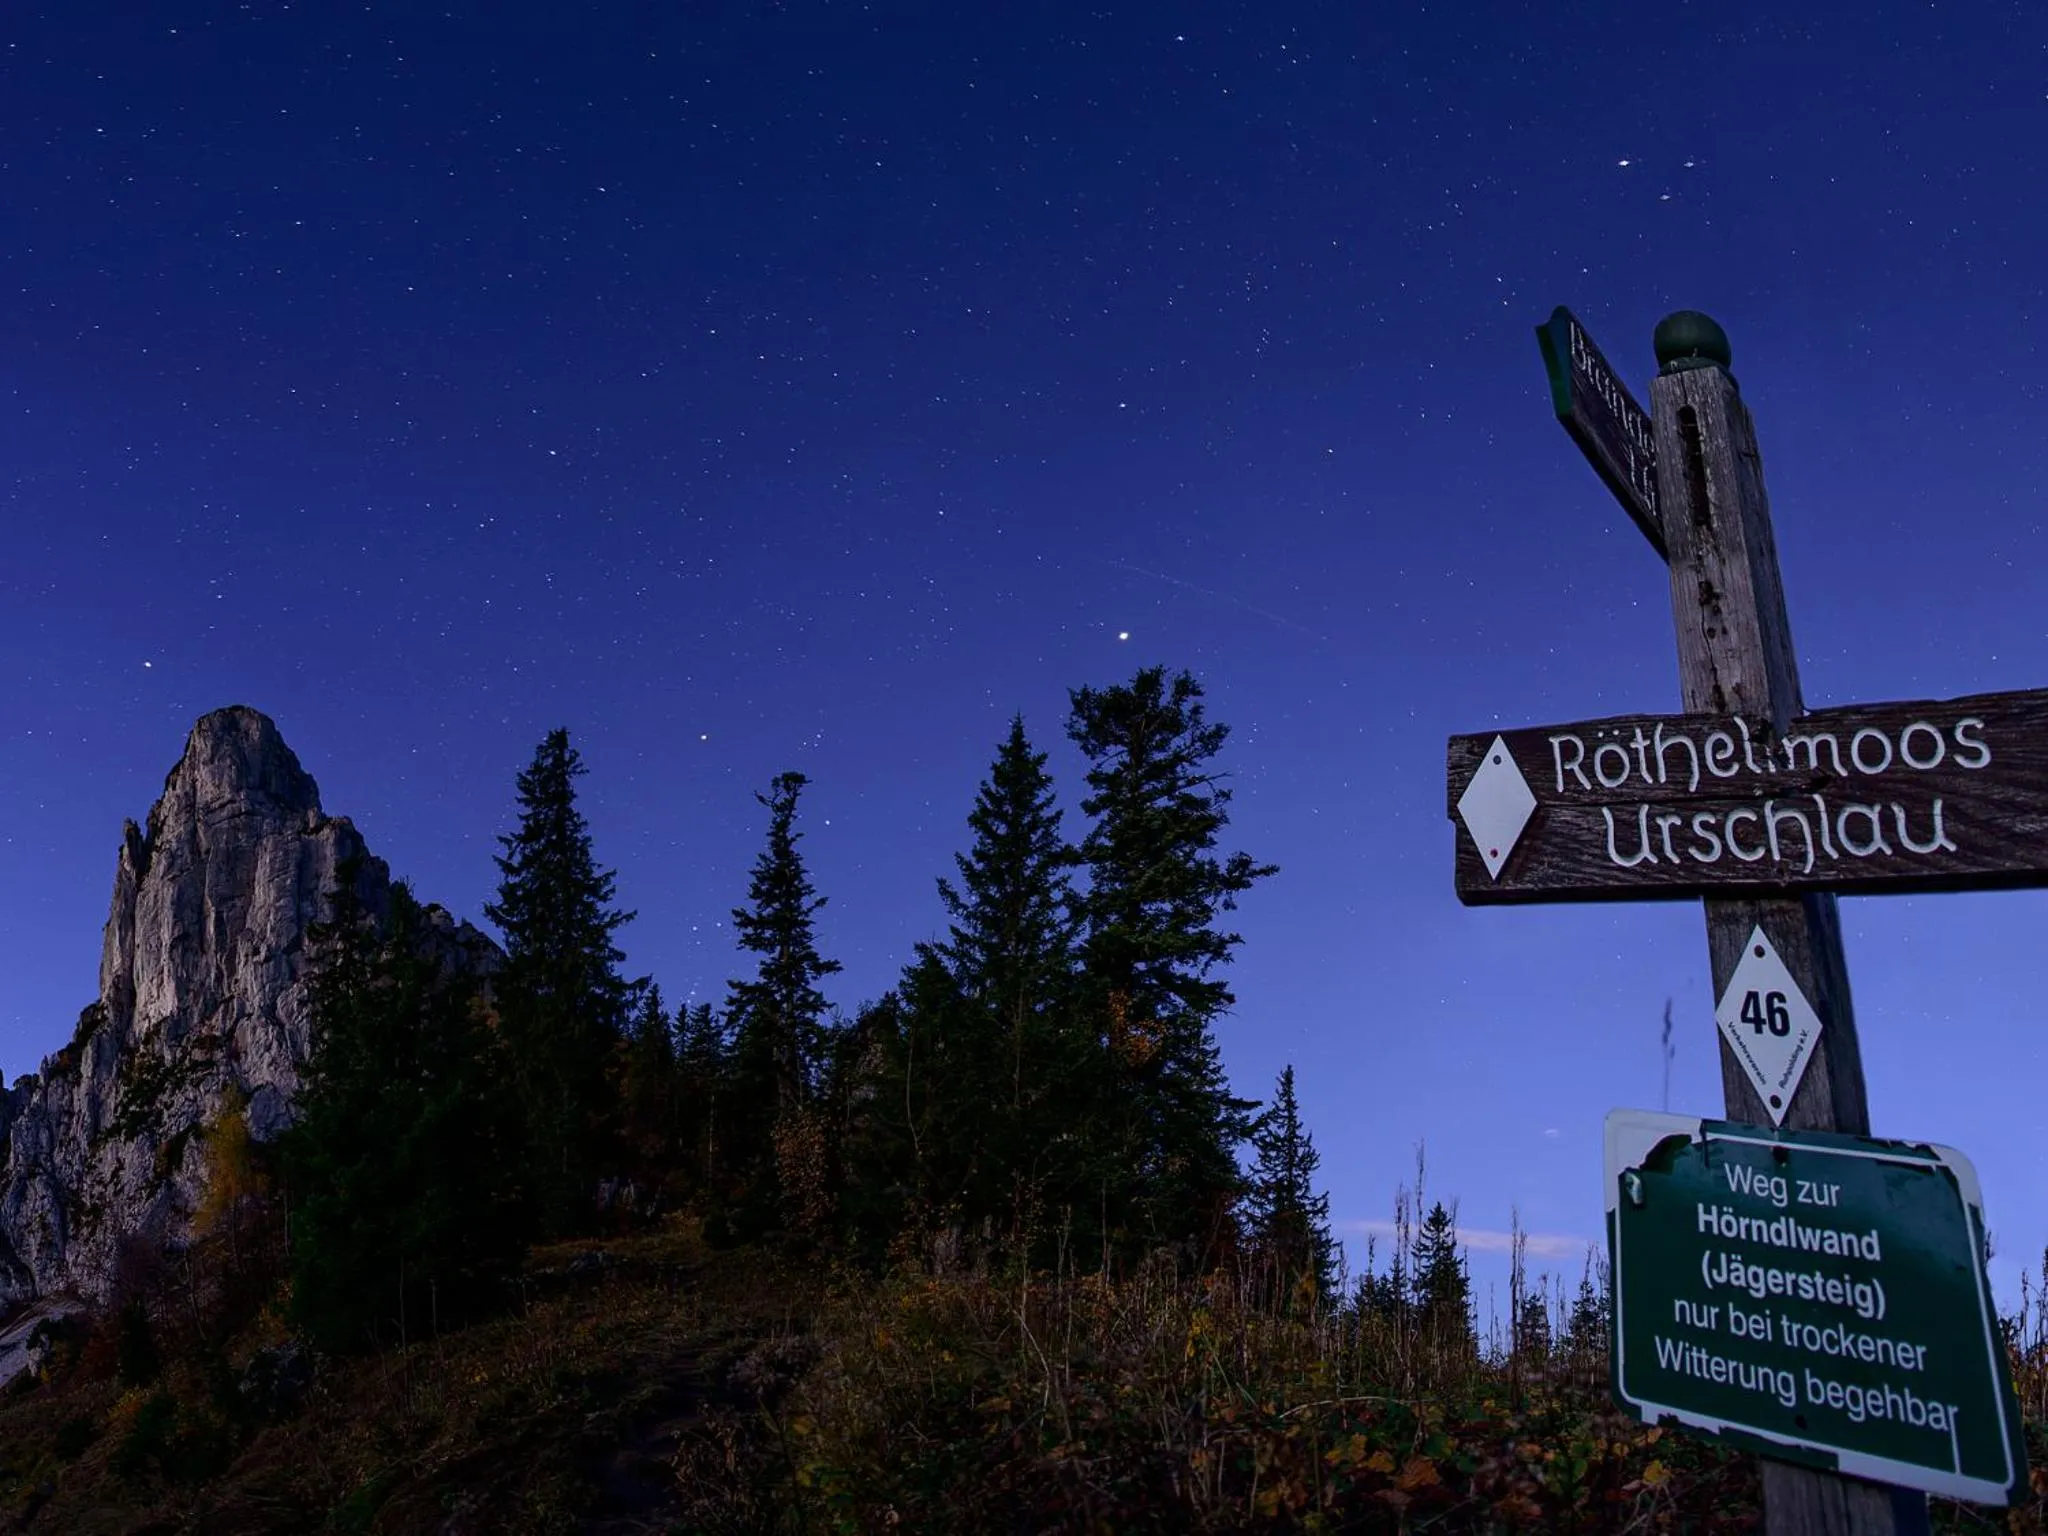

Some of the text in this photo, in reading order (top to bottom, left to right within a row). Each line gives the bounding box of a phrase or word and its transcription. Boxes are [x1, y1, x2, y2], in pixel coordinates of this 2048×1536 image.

[1603, 793, 1957, 874] Urschlau
[1740, 990, 1791, 1038] 46
[1724, 1162, 1839, 1208] Weg zur
[1697, 1203, 1881, 1262] Hörndlwand
[1701, 1250, 1887, 1322] (Jägersteig)
[1674, 1298, 1926, 1372] nur bei trockener
[1654, 1335, 1959, 1434] Witterung begehbar
